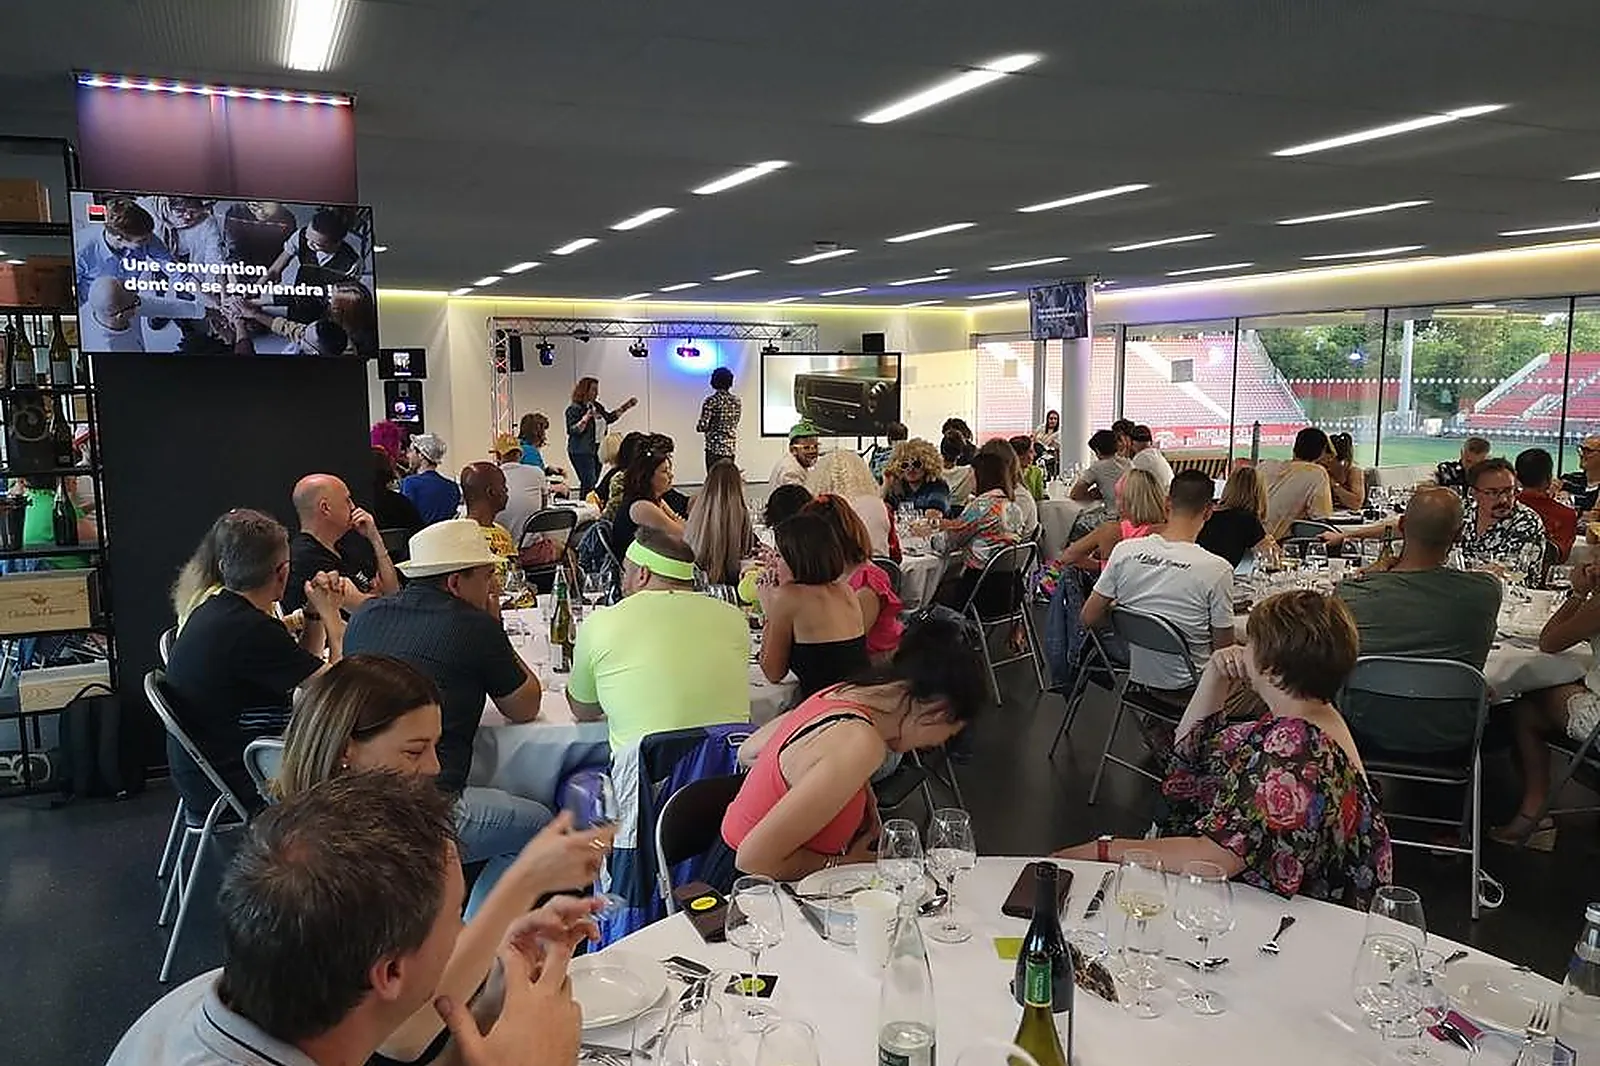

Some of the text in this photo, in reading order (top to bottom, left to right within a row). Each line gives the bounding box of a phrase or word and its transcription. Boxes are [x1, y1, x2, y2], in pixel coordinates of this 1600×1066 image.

[122, 258, 268, 276] Une convention
[124, 277, 169, 291] dont
[173, 281, 197, 292] on
[201, 282, 222, 293] se
[226, 281, 324, 296] souviendra
